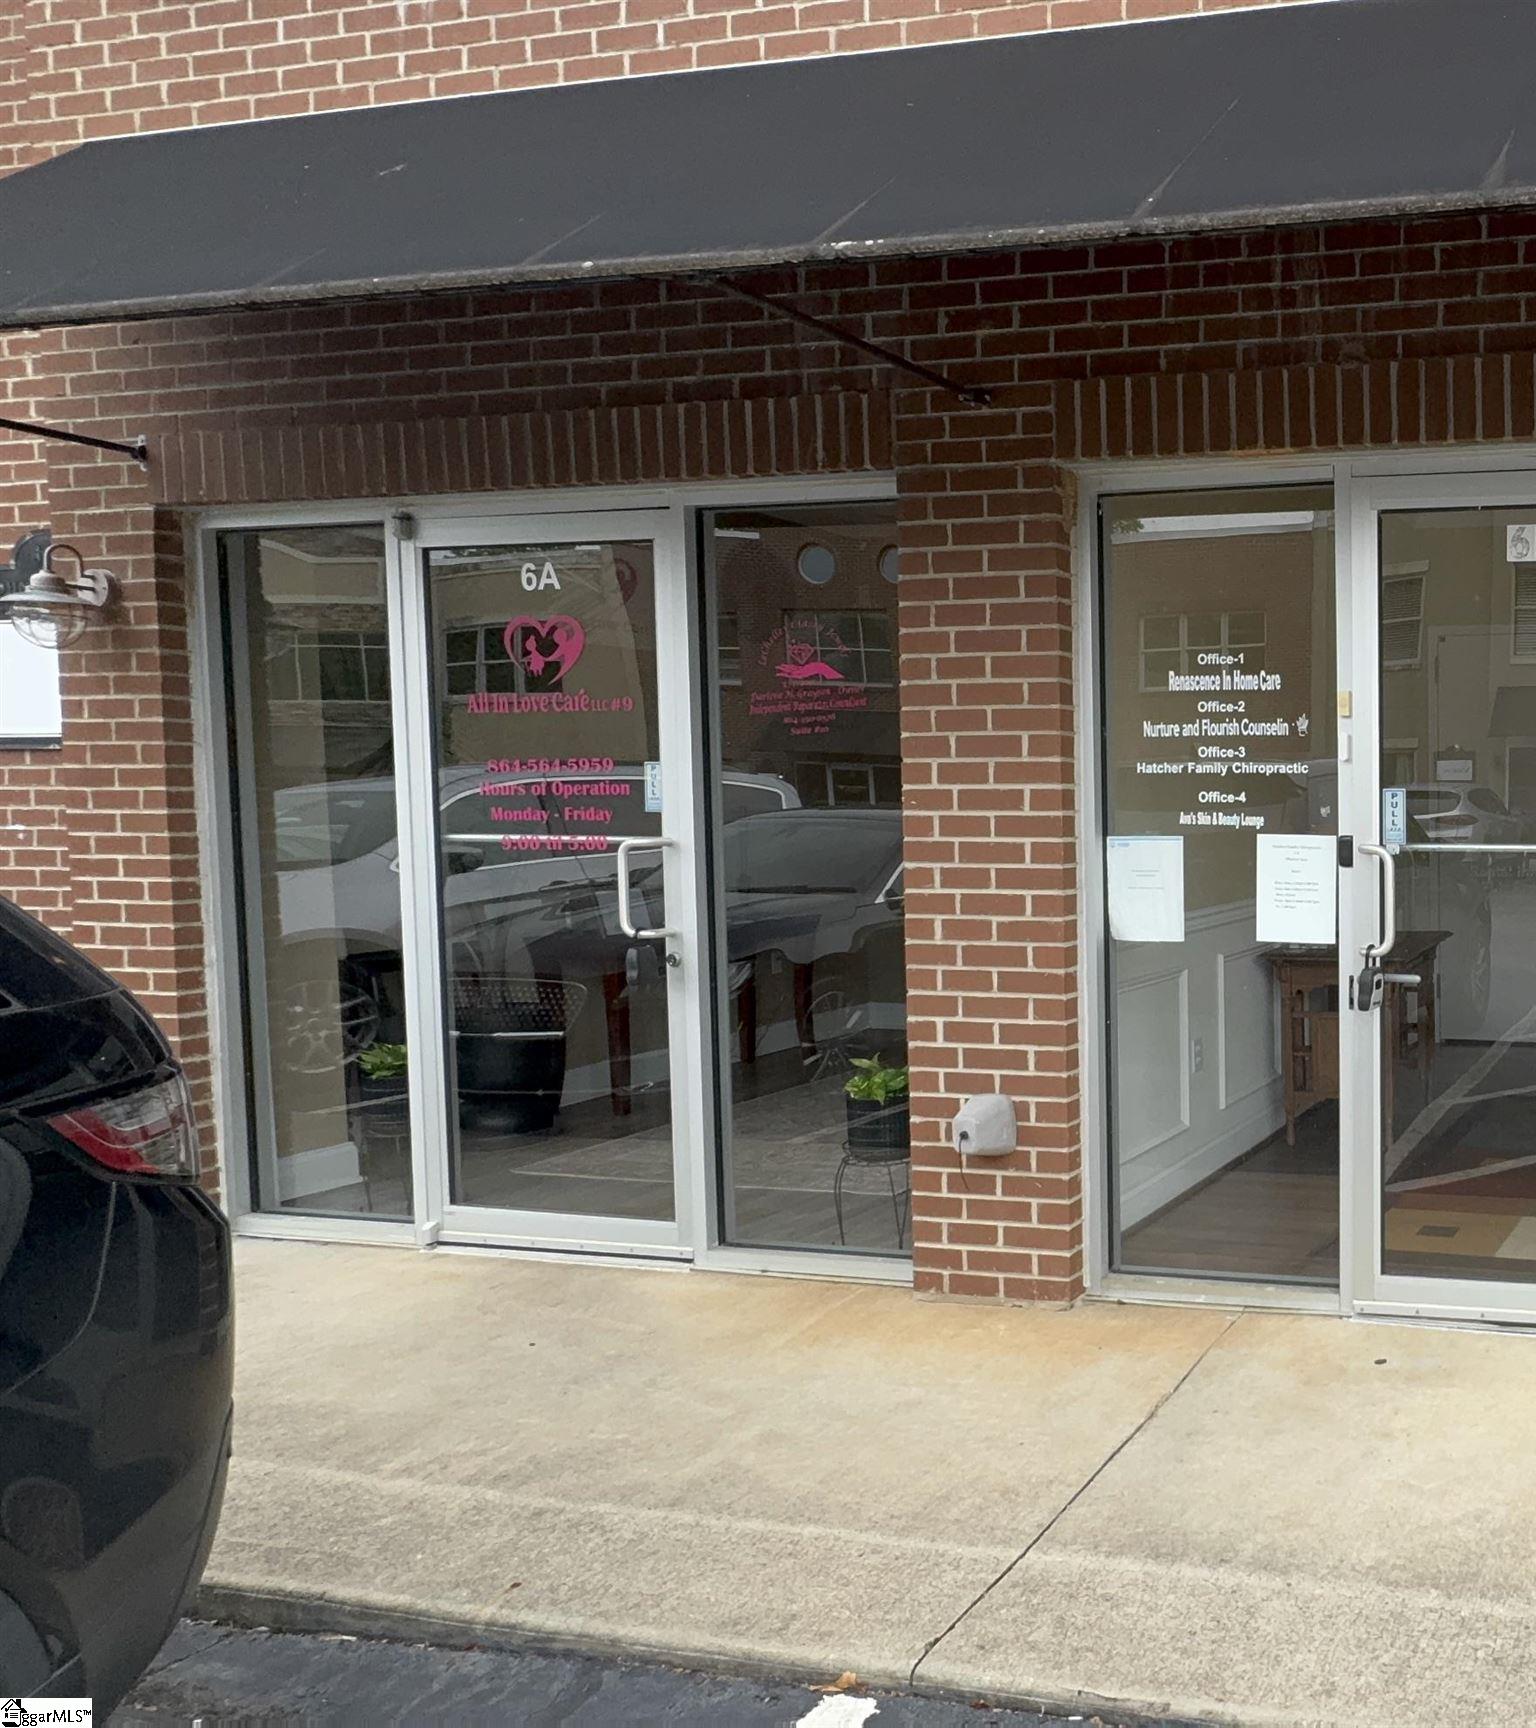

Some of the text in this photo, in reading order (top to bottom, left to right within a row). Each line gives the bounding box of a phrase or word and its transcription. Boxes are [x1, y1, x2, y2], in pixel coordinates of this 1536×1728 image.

[521, 562, 561, 591] 6A
[1197, 653, 1244, 665] Office-1
[1169, 670, 1281, 691] Renascence In Home Care
[467, 692, 489, 714] All
[494, 692, 509, 714] In
[514, 693, 549, 713] Love
[1197, 701, 1245, 713] Office-2
[1143, 720, 1180, 738] Nurture
[1182, 719, 1199, 737] and
[1202, 718, 1239, 736] Flourish
[1198, 746, 1246, 758] Office-3
[487, 757, 614, 774] 864-564-5959
[1137, 761, 1309, 776] Hatcher Family Chiropractic
[480, 781, 630, 798] Hours of Operation
[1199, 792, 1246, 803] Office-4
[490, 807, 550, 824] Monday
[564, 807, 613, 824] Friday
[1391, 792, 1399, 826] PULL
